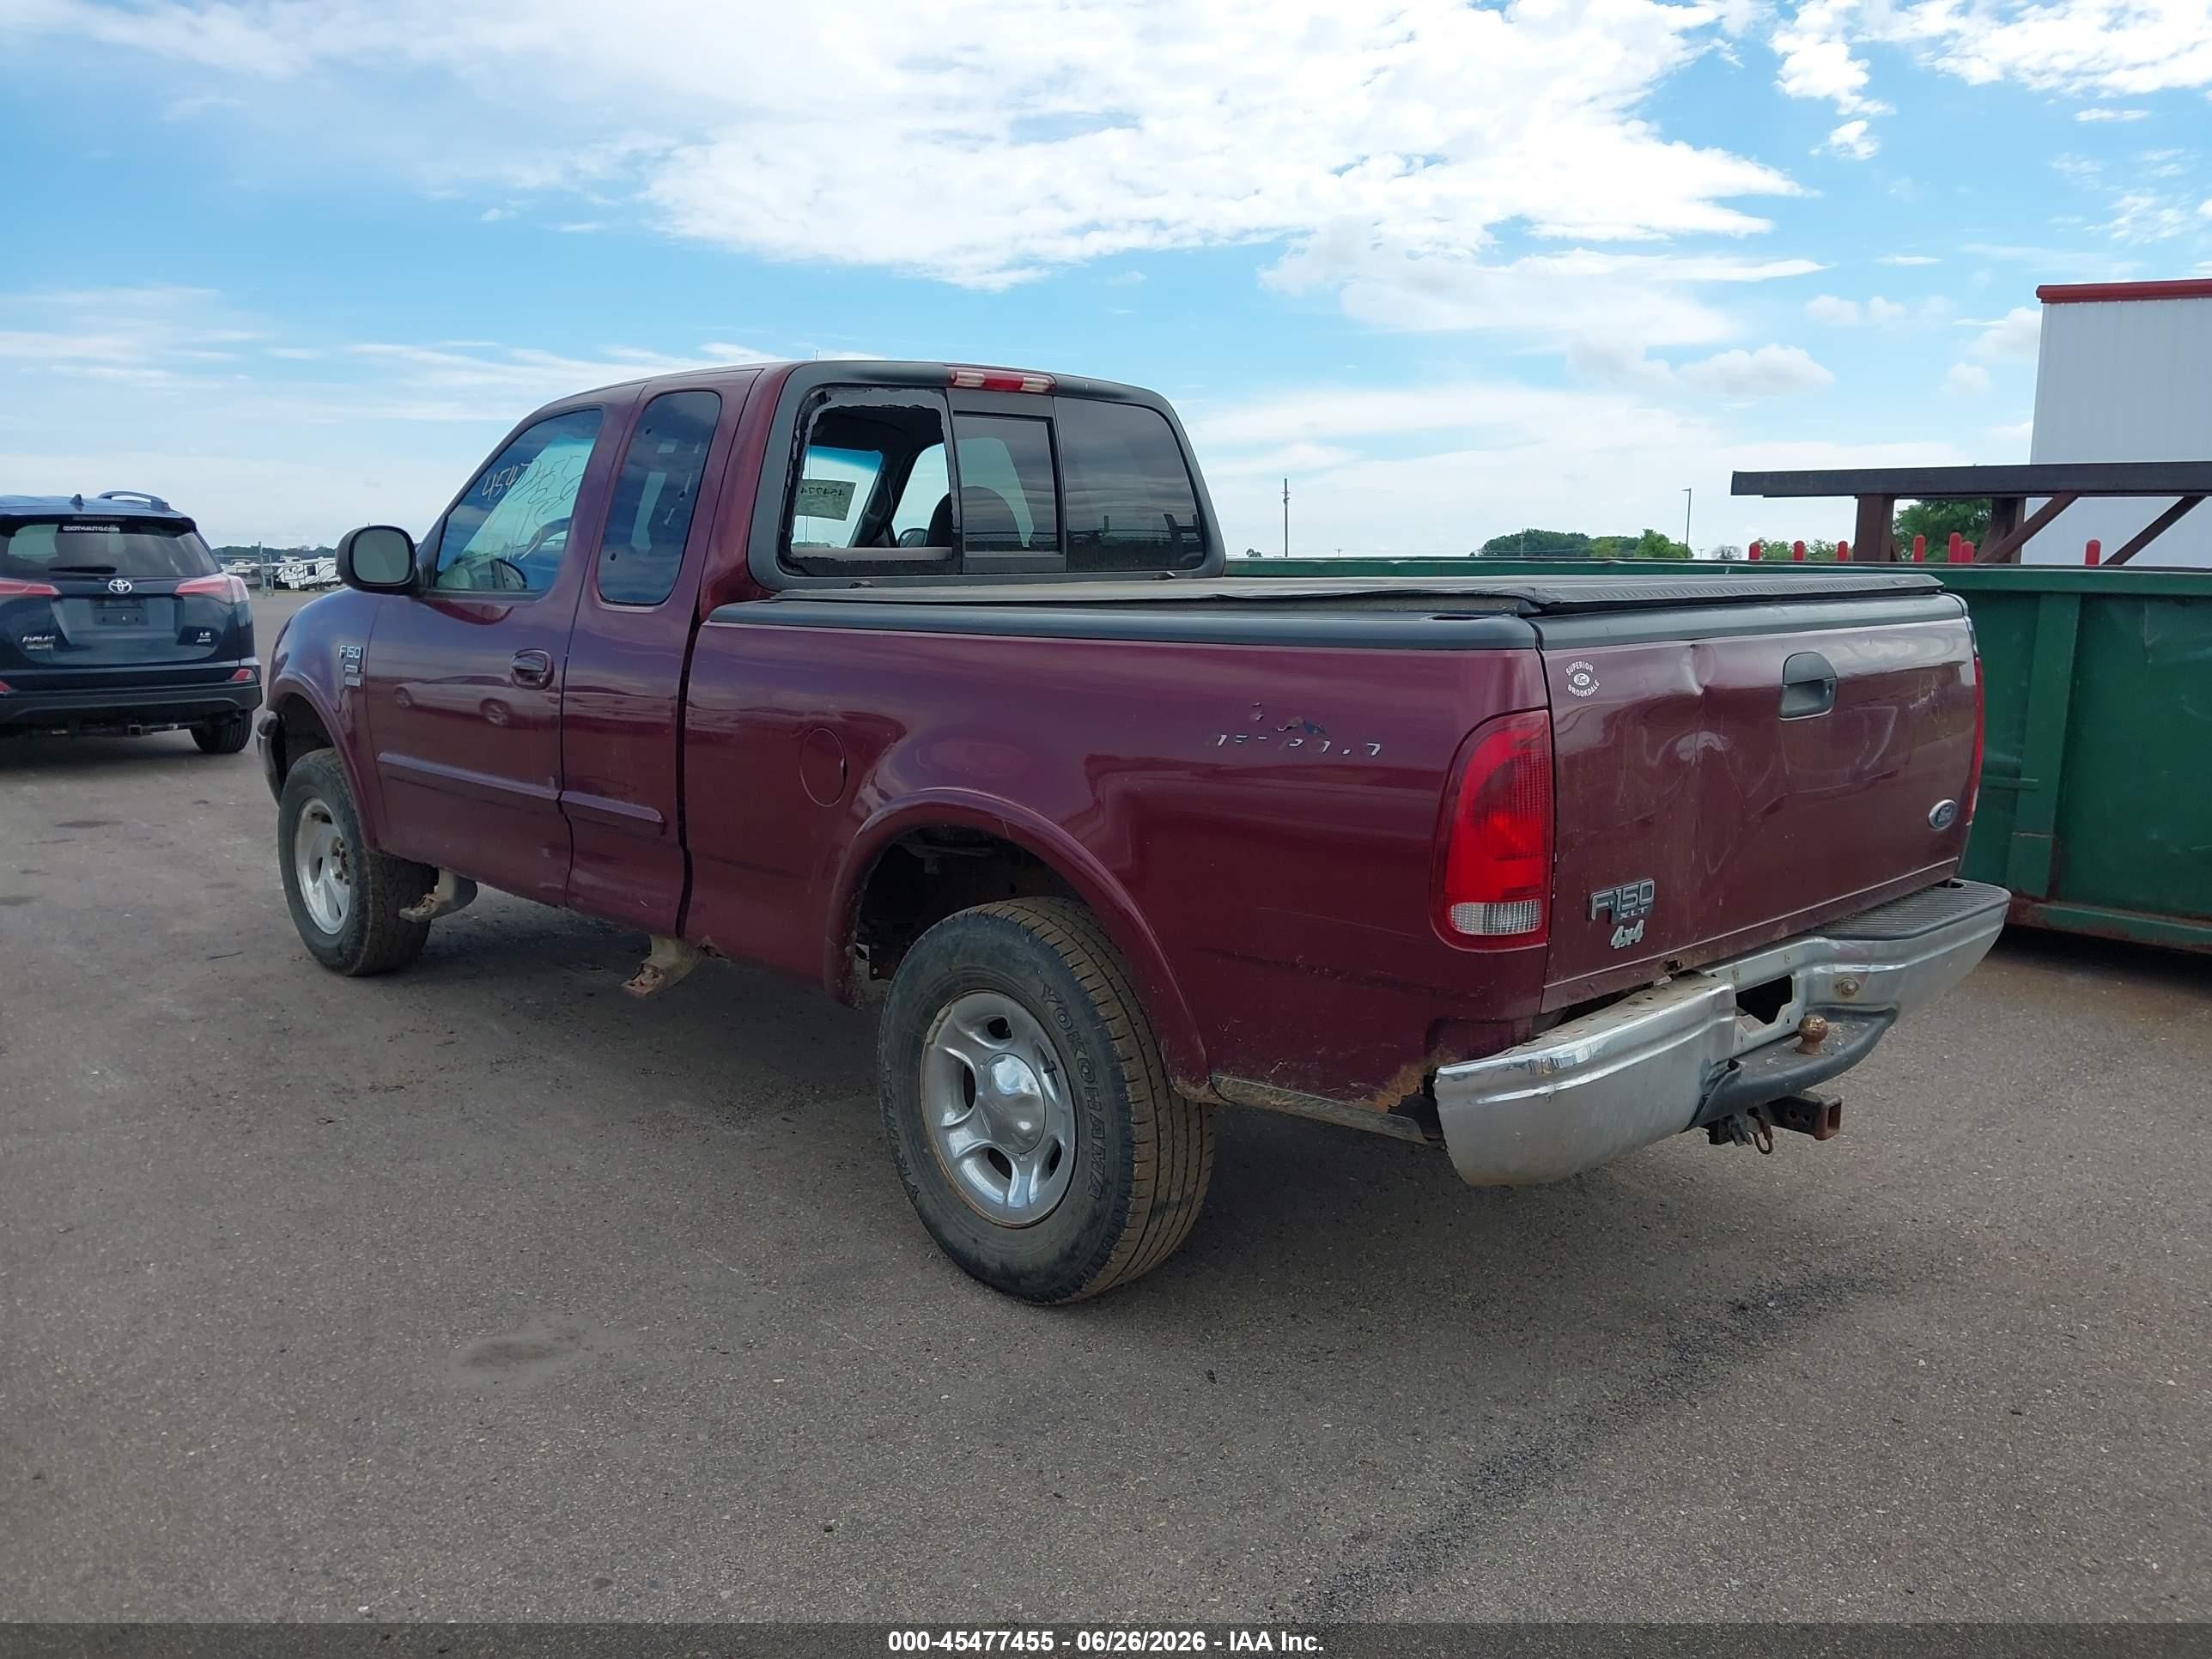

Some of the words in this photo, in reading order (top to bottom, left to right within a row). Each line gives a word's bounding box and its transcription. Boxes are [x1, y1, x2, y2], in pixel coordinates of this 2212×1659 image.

[1565, 661, 1594, 676] SUPERIOR
[1567, 679, 1600, 697] BROOKDALE
[1620, 906, 1649, 920] XLT
[1039, 982, 1106, 1200] YOKOHAMA
